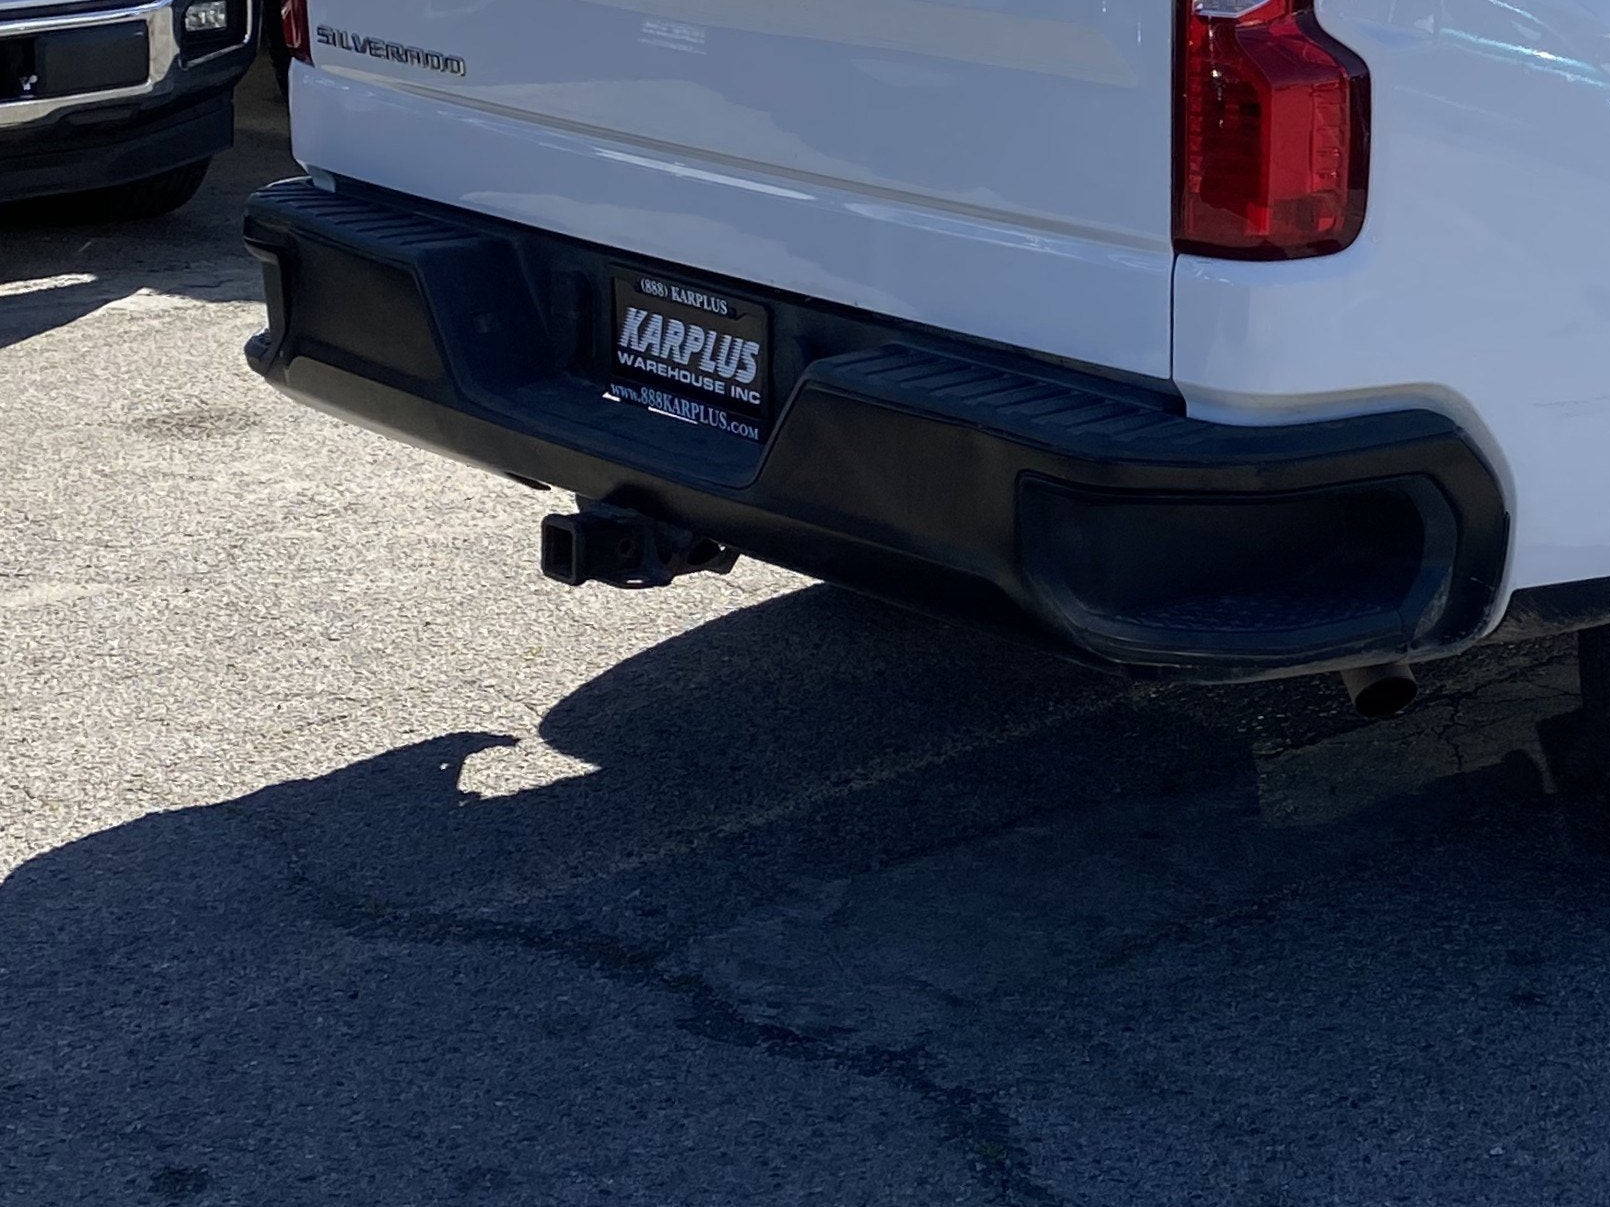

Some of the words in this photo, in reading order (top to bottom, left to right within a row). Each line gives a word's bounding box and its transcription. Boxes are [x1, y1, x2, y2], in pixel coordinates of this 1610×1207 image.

[316, 24, 466, 77] SILVERADO
[640, 277, 668, 297] (888)
[671, 285, 729, 316] KARPLUS
[618, 306, 760, 384] KARPLUS
[617, 349, 725, 394] WAREHOUSE
[731, 386, 761, 405] INC
